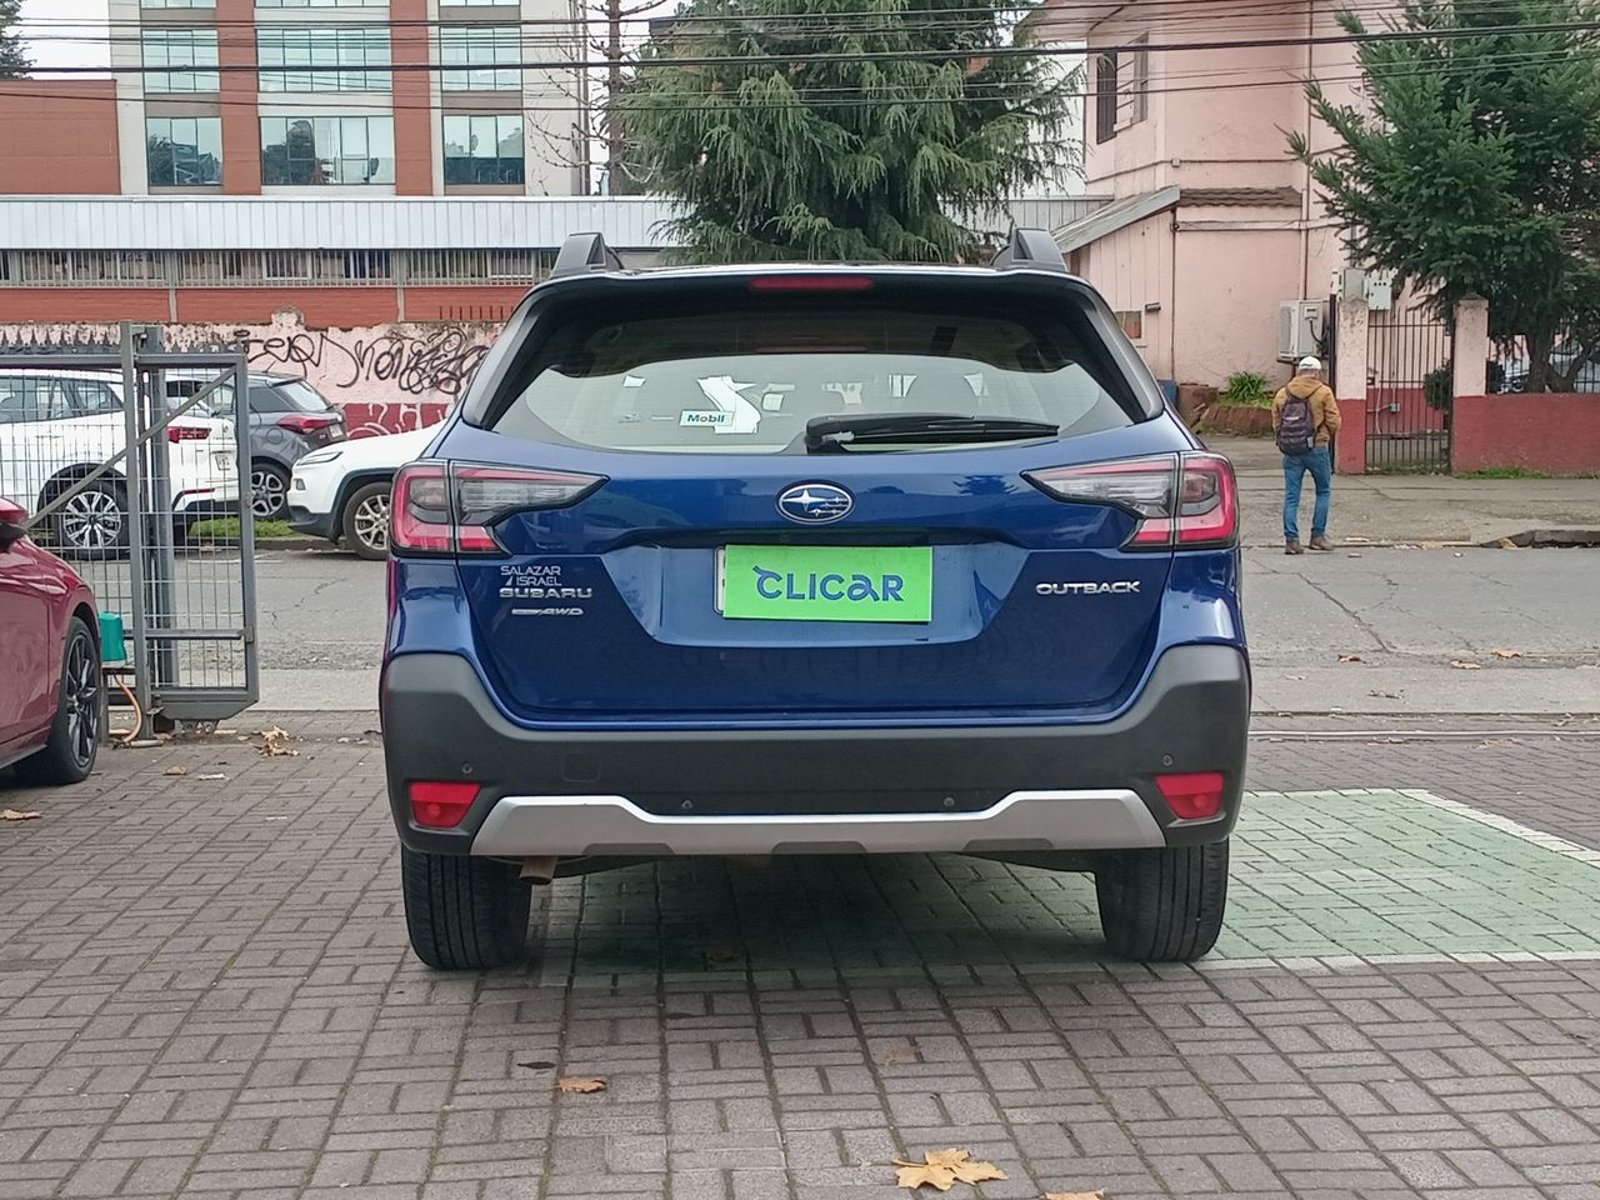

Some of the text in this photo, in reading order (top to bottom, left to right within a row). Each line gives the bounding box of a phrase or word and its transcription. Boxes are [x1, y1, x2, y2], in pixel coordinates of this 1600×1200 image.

[687, 414, 725, 423] Mobil
[500, 565, 561, 576] SALAZAR
[516, 576, 562, 586] ISRAEL
[499, 587, 592, 598] SUBARU
[1035, 581, 1140, 595] OUTBACK
